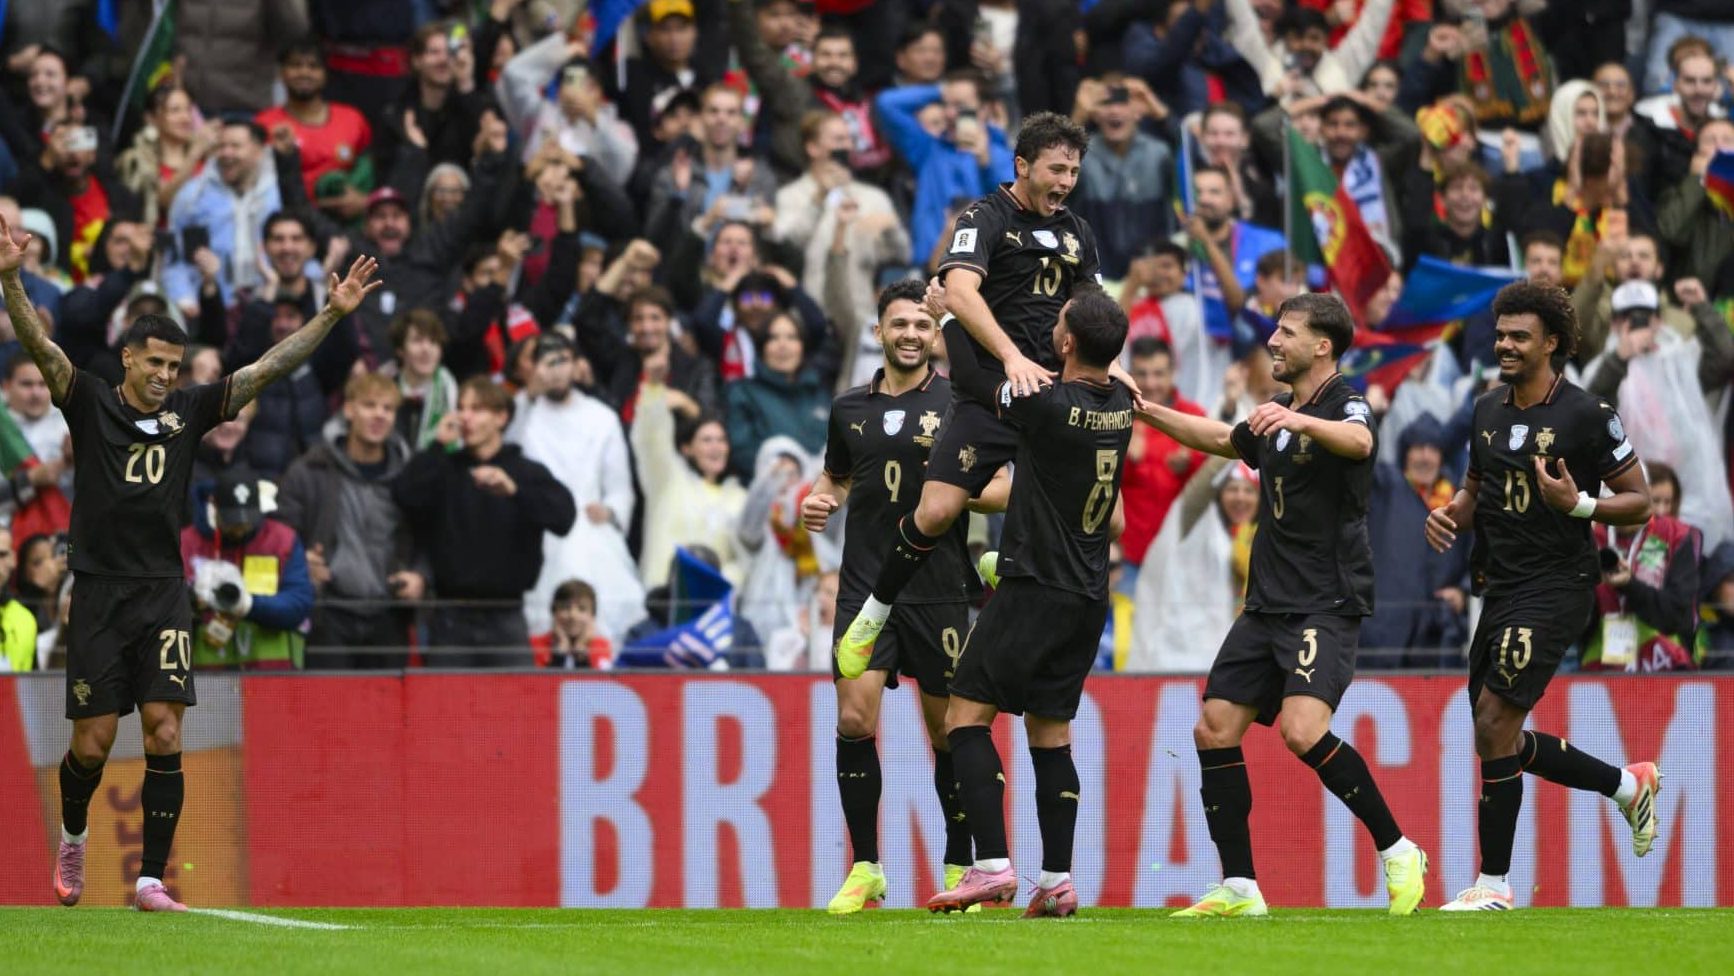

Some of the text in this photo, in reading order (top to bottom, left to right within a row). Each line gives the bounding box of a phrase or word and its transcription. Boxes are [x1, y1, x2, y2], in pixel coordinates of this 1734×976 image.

[1068, 406, 1081, 427] B.
[125, 442, 166, 484] 20
[884, 460, 901, 502] 9
[1082, 449, 1118, 535] 8
[1273, 476, 1284, 519] 3
[1502, 470, 1531, 513] 13
[159, 629, 191, 671] 20
[942, 626, 959, 672] 9
[1298, 628, 1317, 666] 3
[1498, 626, 1532, 669] 13
[1324, 680, 1717, 908] COM
